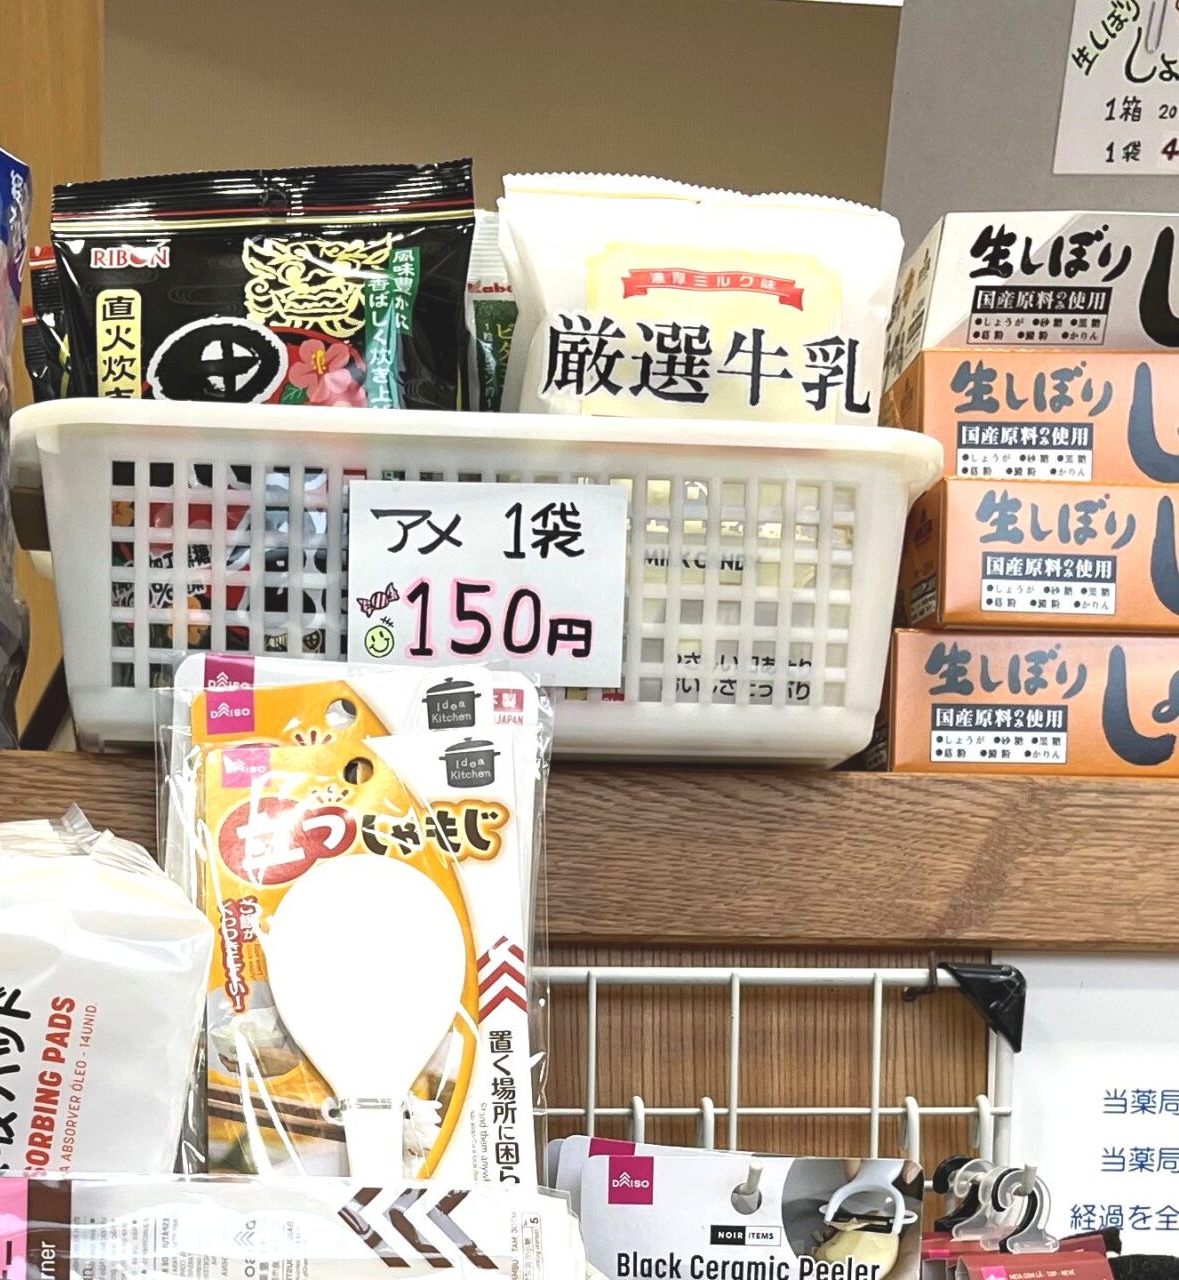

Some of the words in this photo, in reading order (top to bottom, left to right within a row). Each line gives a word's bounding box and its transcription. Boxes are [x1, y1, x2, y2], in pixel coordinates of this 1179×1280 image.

[1104, 96, 1142, 122] 1箱
[1105, 141, 1142, 163] 1袋
[90, 247, 170, 270] RIBON
[969, 224, 1132, 282] 生しぼり
[390, 249, 415, 331] 風味豊かに
[976, 289, 1107, 311] 国産原料のみ使用
[543, 314, 871, 414] 厳選牛乳
[951, 359, 1113, 417] 生しぼり
[961, 425, 1089, 446] 国産原料のみ使用
[370, 507, 463, 554] アメ
[503, 501, 585, 560] 1袋
[976, 489, 1136, 550] 生しぼり
[986, 556, 1113, 579] 国産原料のみ使用
[405, 580, 592, 658] 150円
[924, 641, 1088, 700] 生しぼり
[431, 710, 473, 724] Kitchen
[436, 699, 469, 713] Idea
[935, 708, 1064, 729] 国産原料のみ使用
[450, 769, 492, 783] Kitchen
[454, 757, 487, 771] Idea
[41, 996, 76, 1064] PADS
[488, 1028, 522, 1184] 置く場所に困ら
[61, 1094, 82, 1163] ABSORVER
[612, 1172, 650, 1188] DAISO
[718, 1231, 744, 1240] NOIR
[748, 1231, 775, 1240] ITEMS
[617, 1252, 683, 1280] Black
